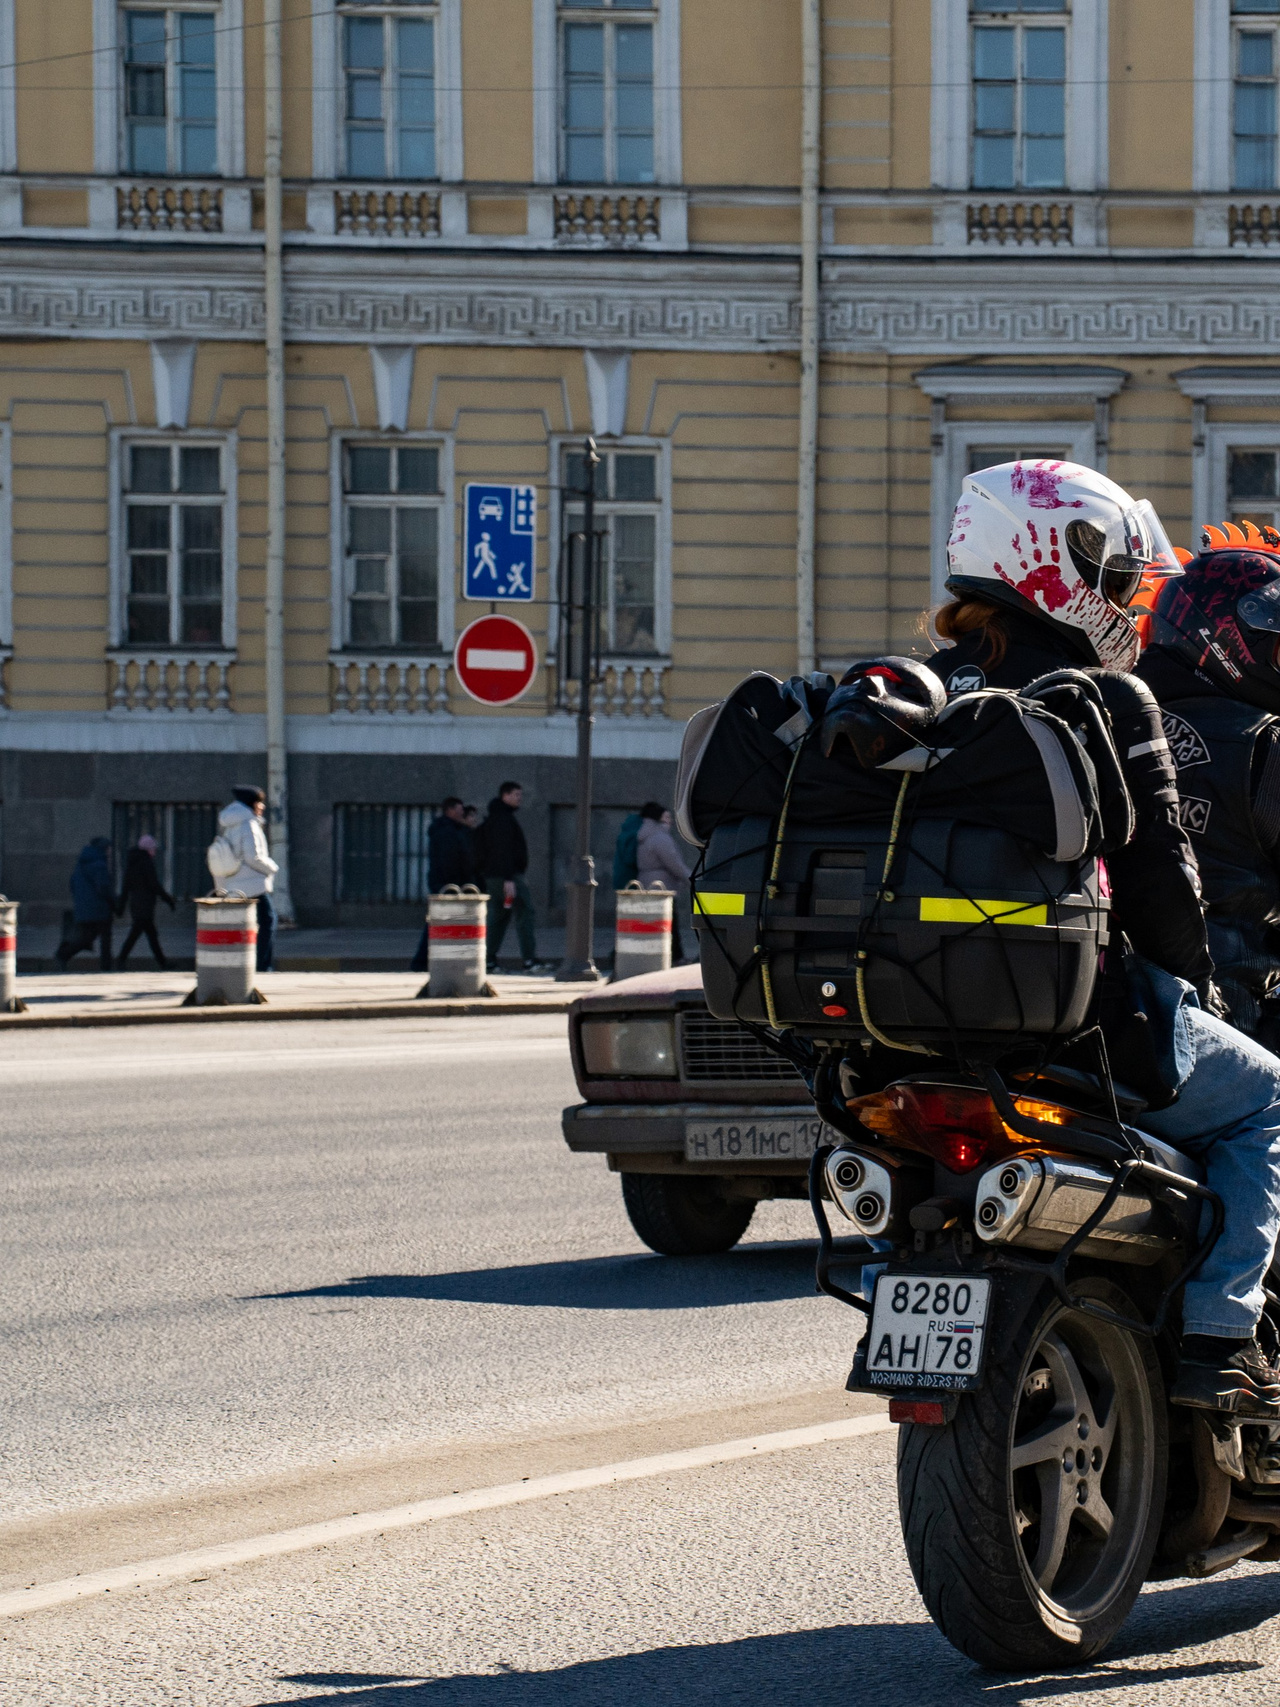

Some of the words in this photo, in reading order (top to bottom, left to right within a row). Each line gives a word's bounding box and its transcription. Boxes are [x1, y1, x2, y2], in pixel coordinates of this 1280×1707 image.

[891, 1281, 972, 1315] 8280
[928, 1320, 954, 1332] RUS
[873, 1333, 921, 1368] АН
[936, 1336, 973, 1369] 78
[870, 1371, 914, 1386] NORMANS
